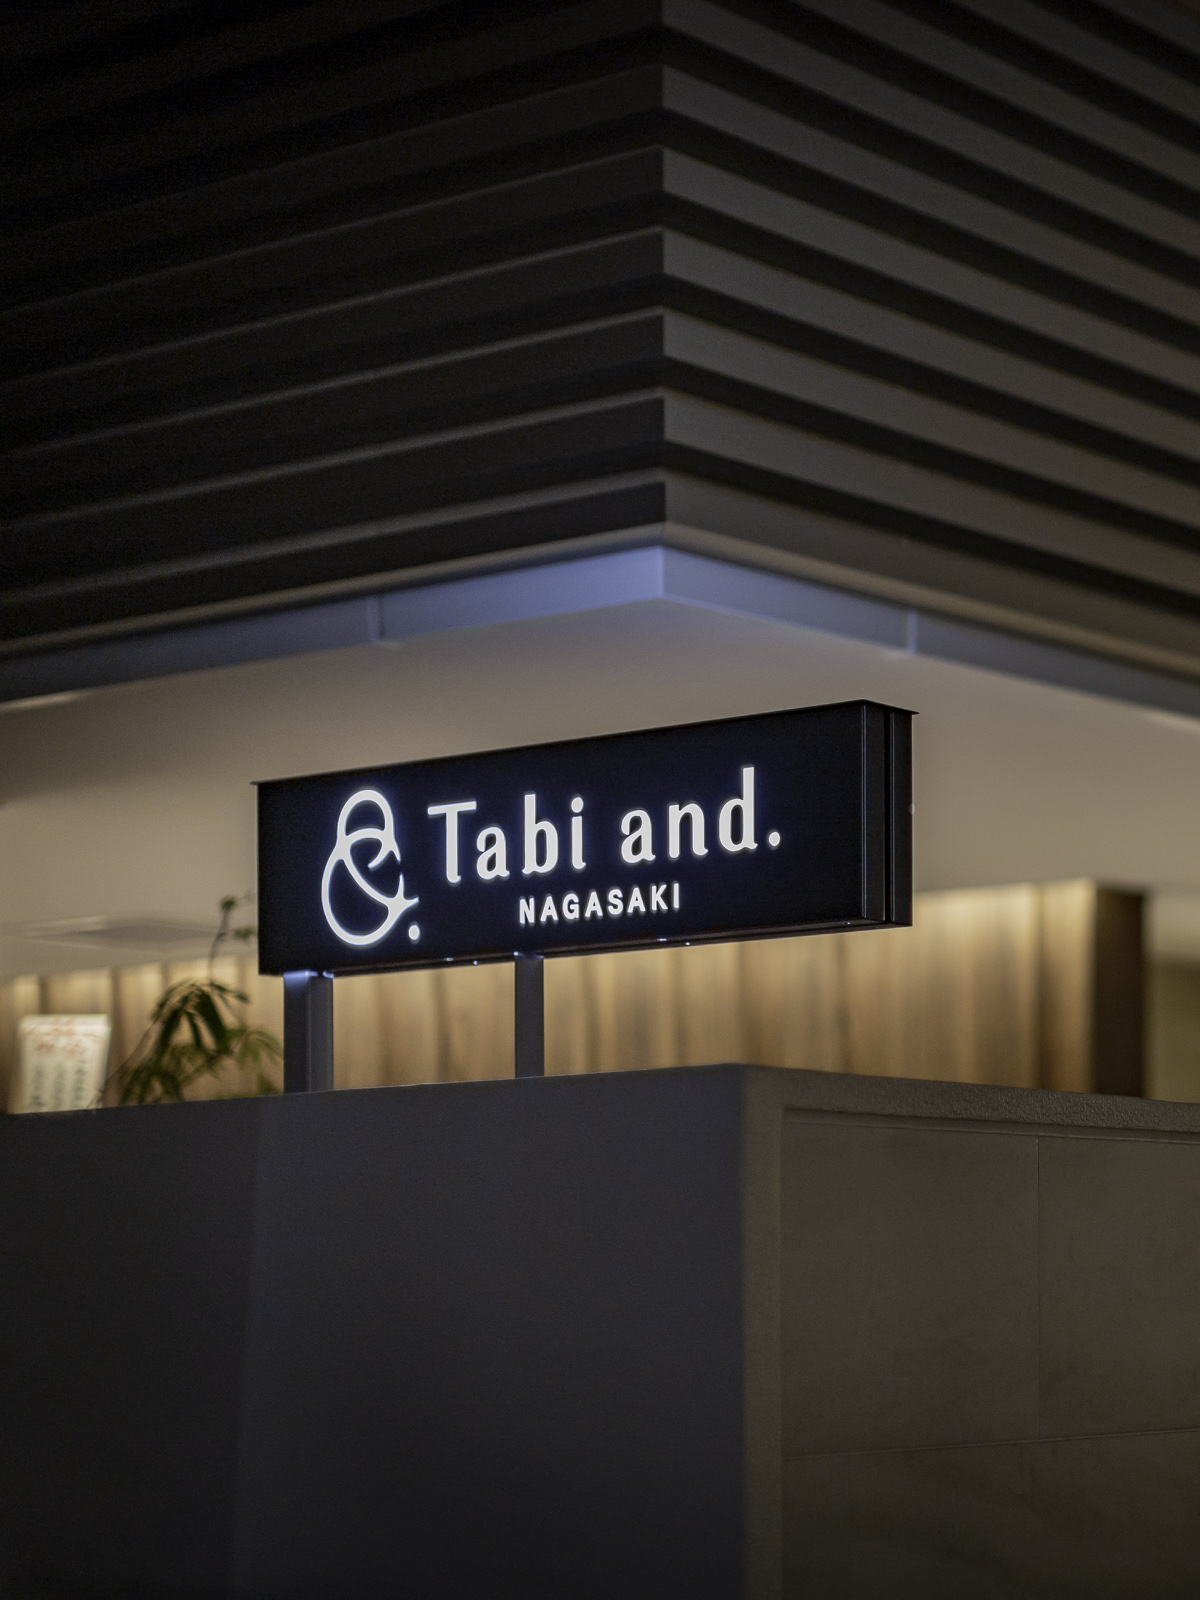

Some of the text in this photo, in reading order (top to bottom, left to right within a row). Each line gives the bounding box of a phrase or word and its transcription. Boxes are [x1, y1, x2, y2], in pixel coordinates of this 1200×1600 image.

[427, 766, 781, 884] Tabi and.
[519, 882, 680, 925] NAGASAKI
